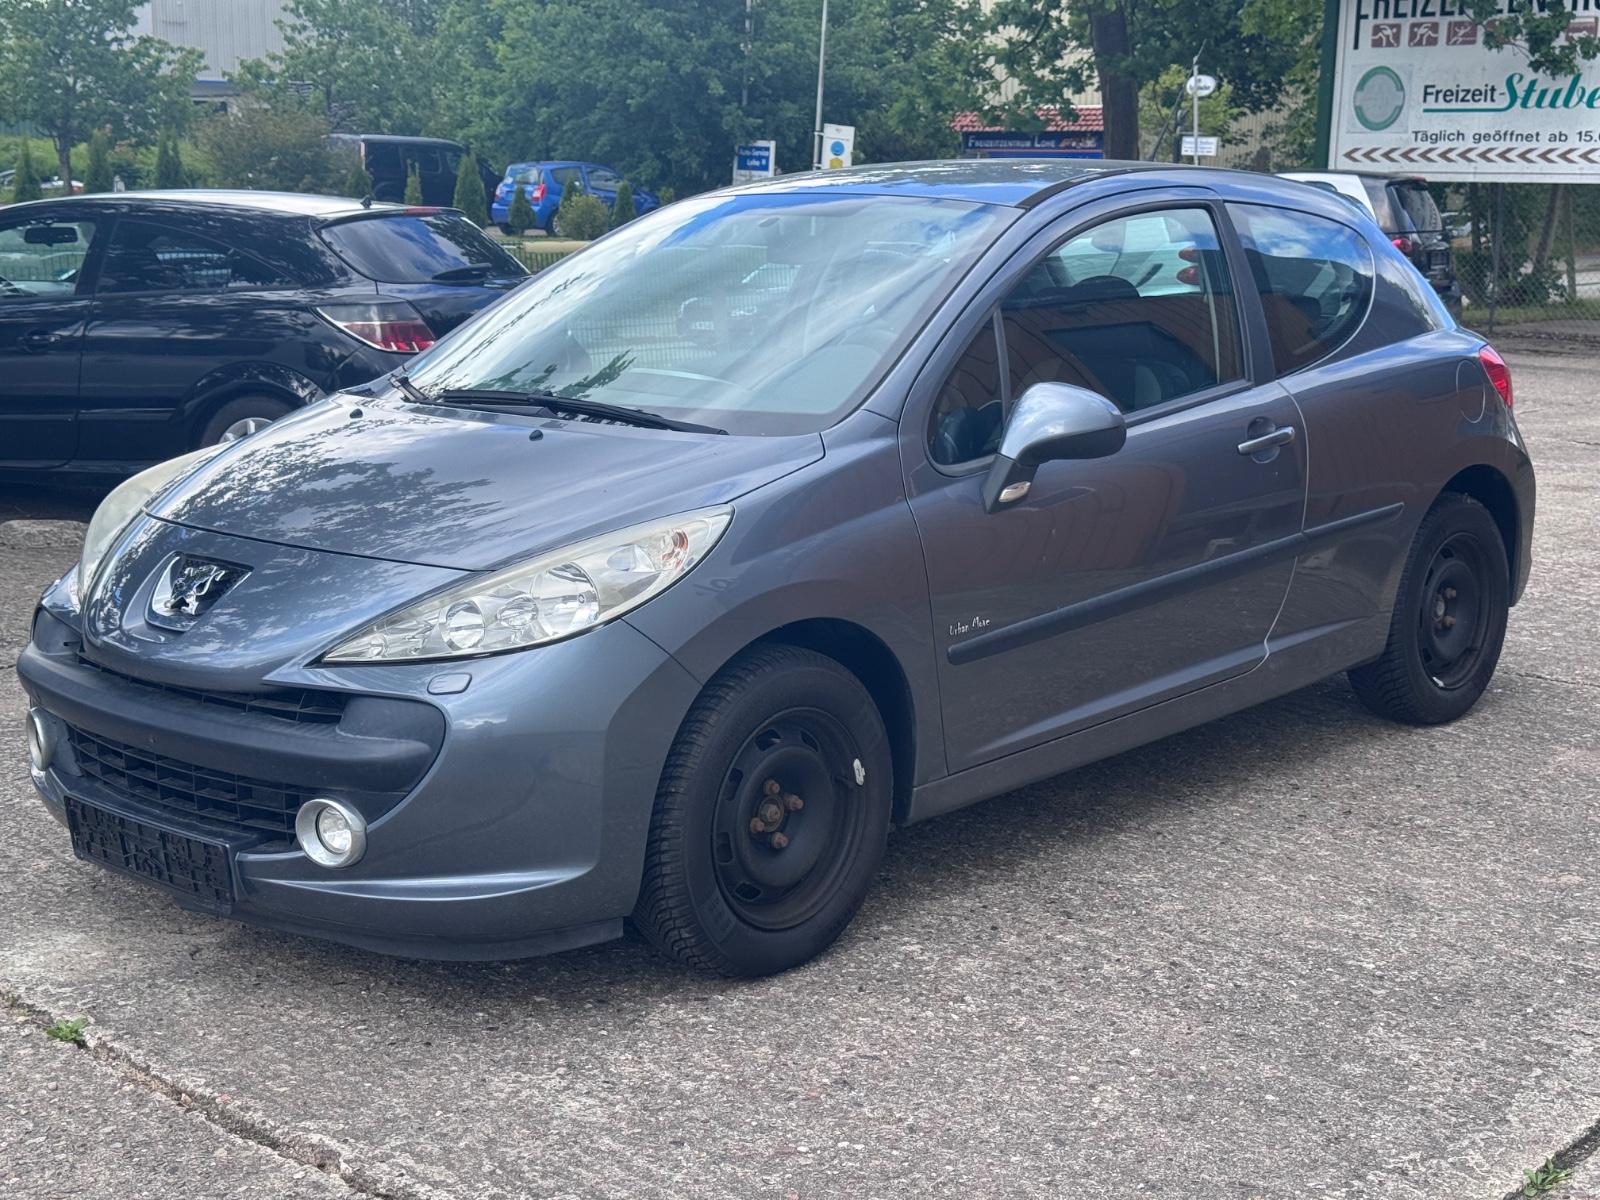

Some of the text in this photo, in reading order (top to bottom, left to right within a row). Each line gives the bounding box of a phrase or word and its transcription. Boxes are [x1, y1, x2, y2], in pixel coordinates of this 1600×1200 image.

[1412, 130, 1465, 143] Täglich
[1472, 131, 1540, 144] geöffnet
[1548, 131, 1568, 143] ab
